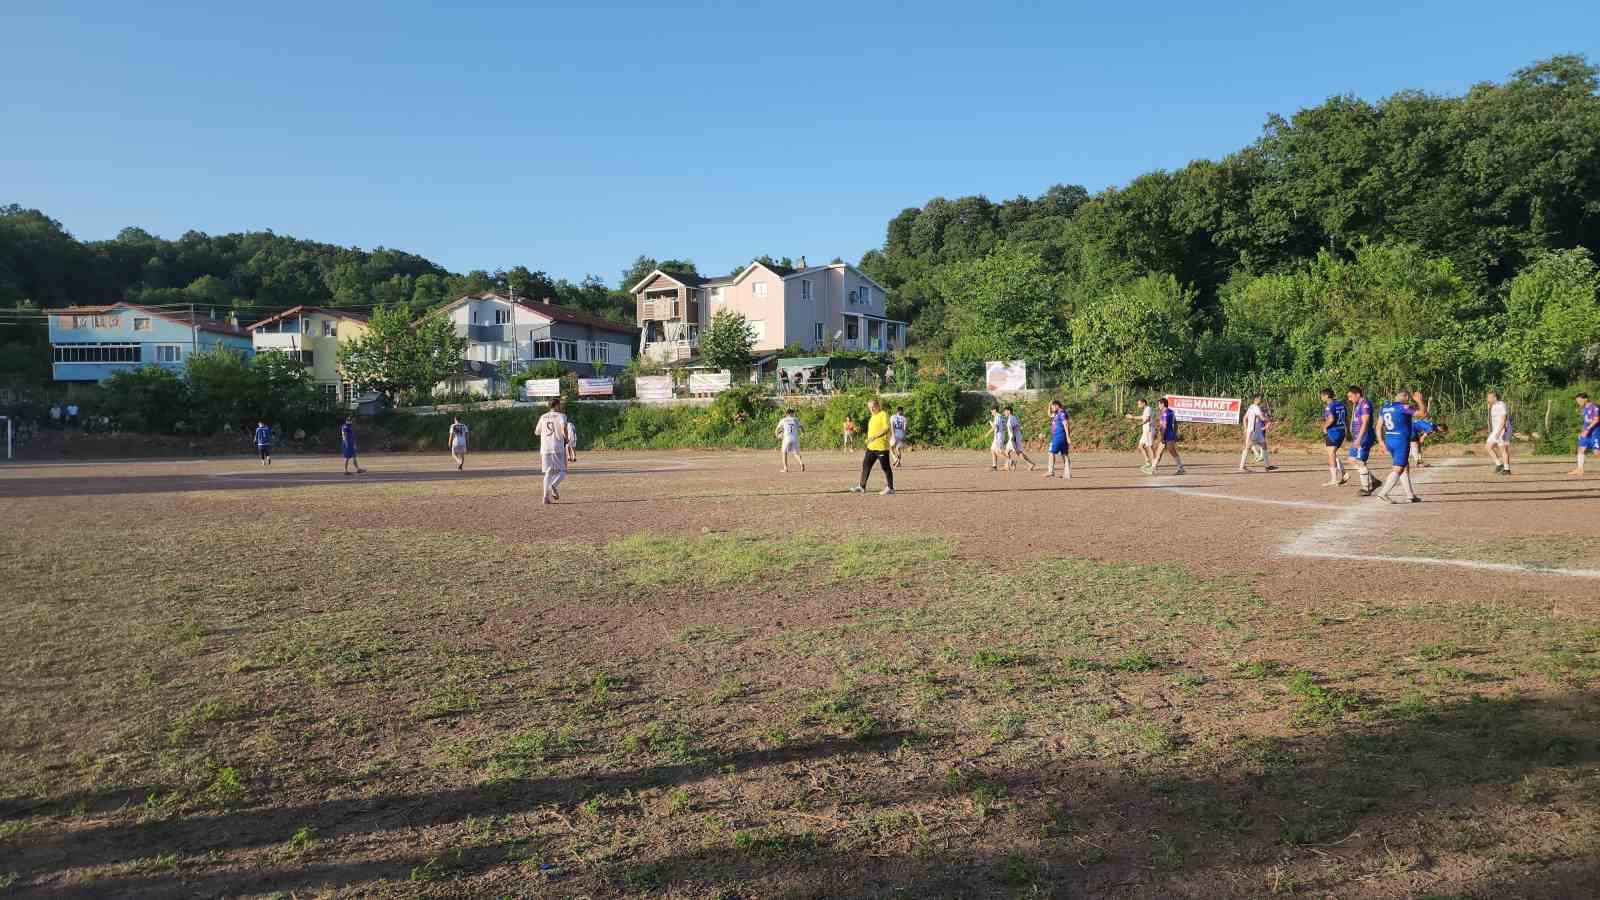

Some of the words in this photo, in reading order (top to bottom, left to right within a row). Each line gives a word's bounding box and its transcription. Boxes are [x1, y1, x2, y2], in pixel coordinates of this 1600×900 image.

[1194, 400, 1233, 410] MARKET
[1336, 410, 1346, 425] 20
[1384, 413, 1395, 430] 8
[546, 421, 555, 436] 9
